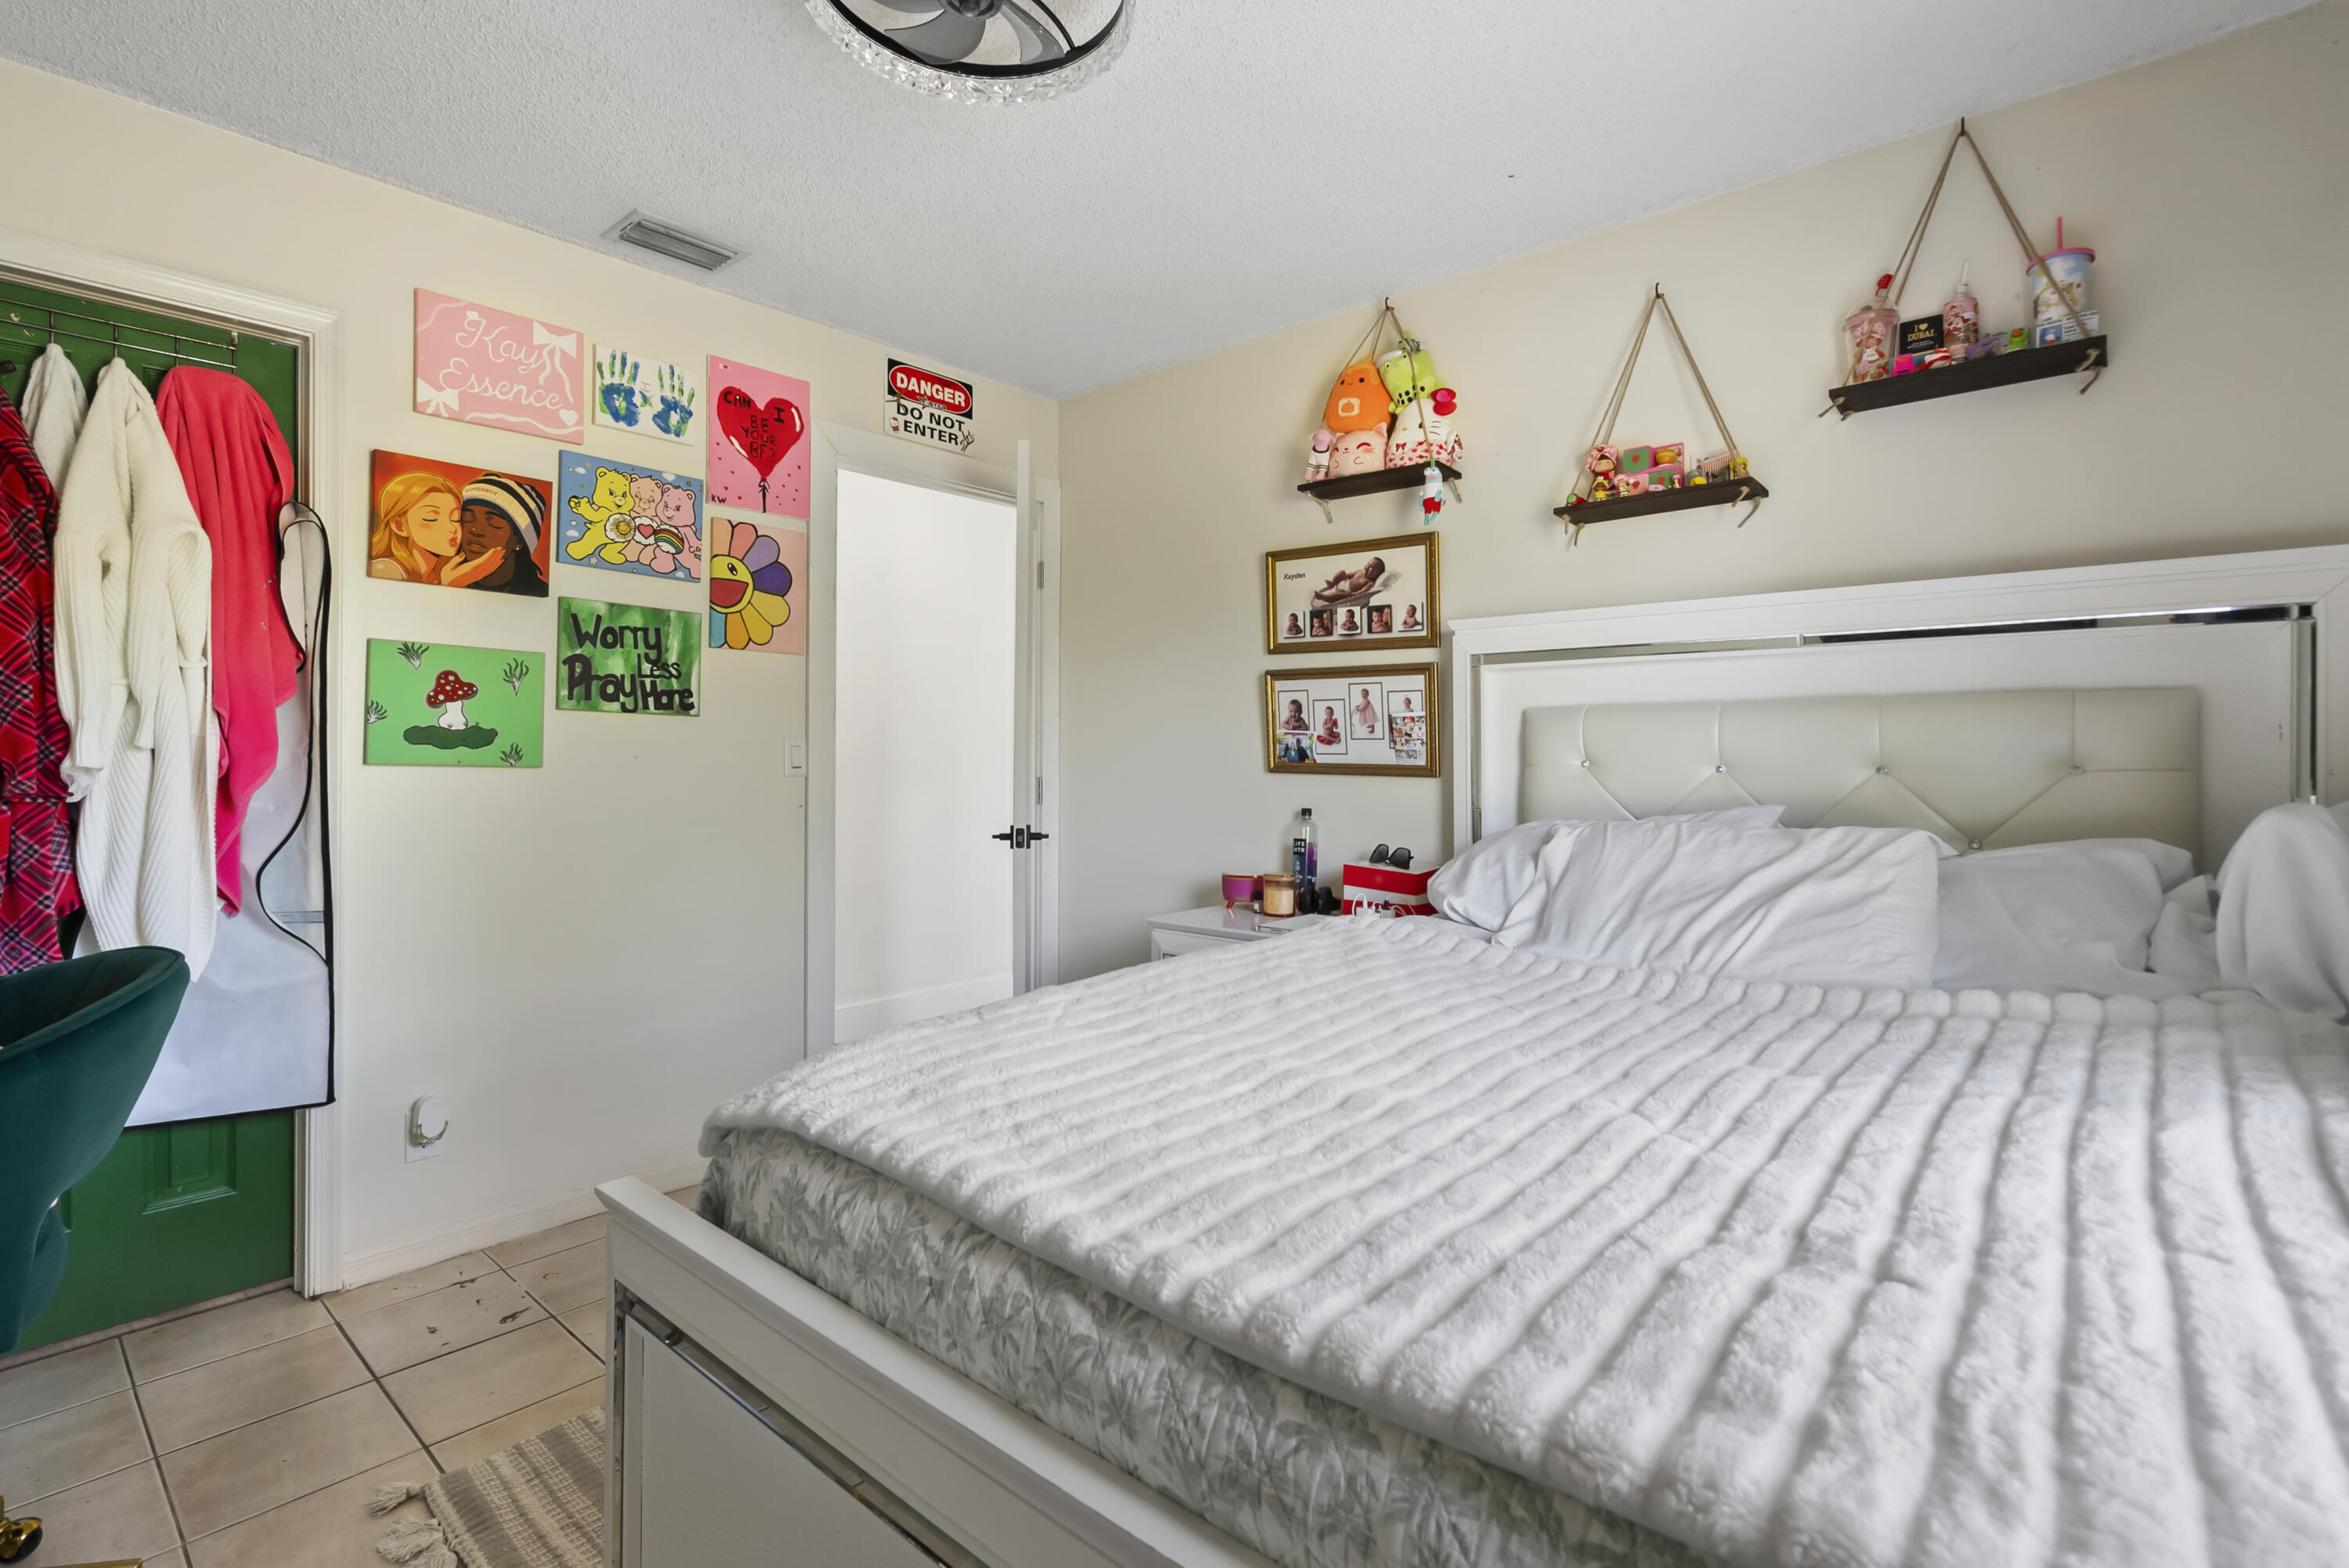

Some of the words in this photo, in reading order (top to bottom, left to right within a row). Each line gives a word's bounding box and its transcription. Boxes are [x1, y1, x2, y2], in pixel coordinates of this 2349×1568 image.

[455, 310, 543, 374] Kay
[1907, 329, 1935, 341] DUBAI
[438, 358, 564, 410] Essence
[897, 372, 965, 407] DANGER
[723, 391, 751, 409] CAN
[774, 406, 785, 424] I
[897, 404, 922, 420] DO
[930, 413, 965, 431] NOT
[741, 427, 777, 447] YOUR
[751, 415, 769, 432] BE
[904, 420, 958, 445] ENTER
[465, 487, 498, 496] LOVERBOY
[571, 613, 662, 665] Worry
[637, 653, 682, 679] Less
[562, 653, 638, 713] Pray
